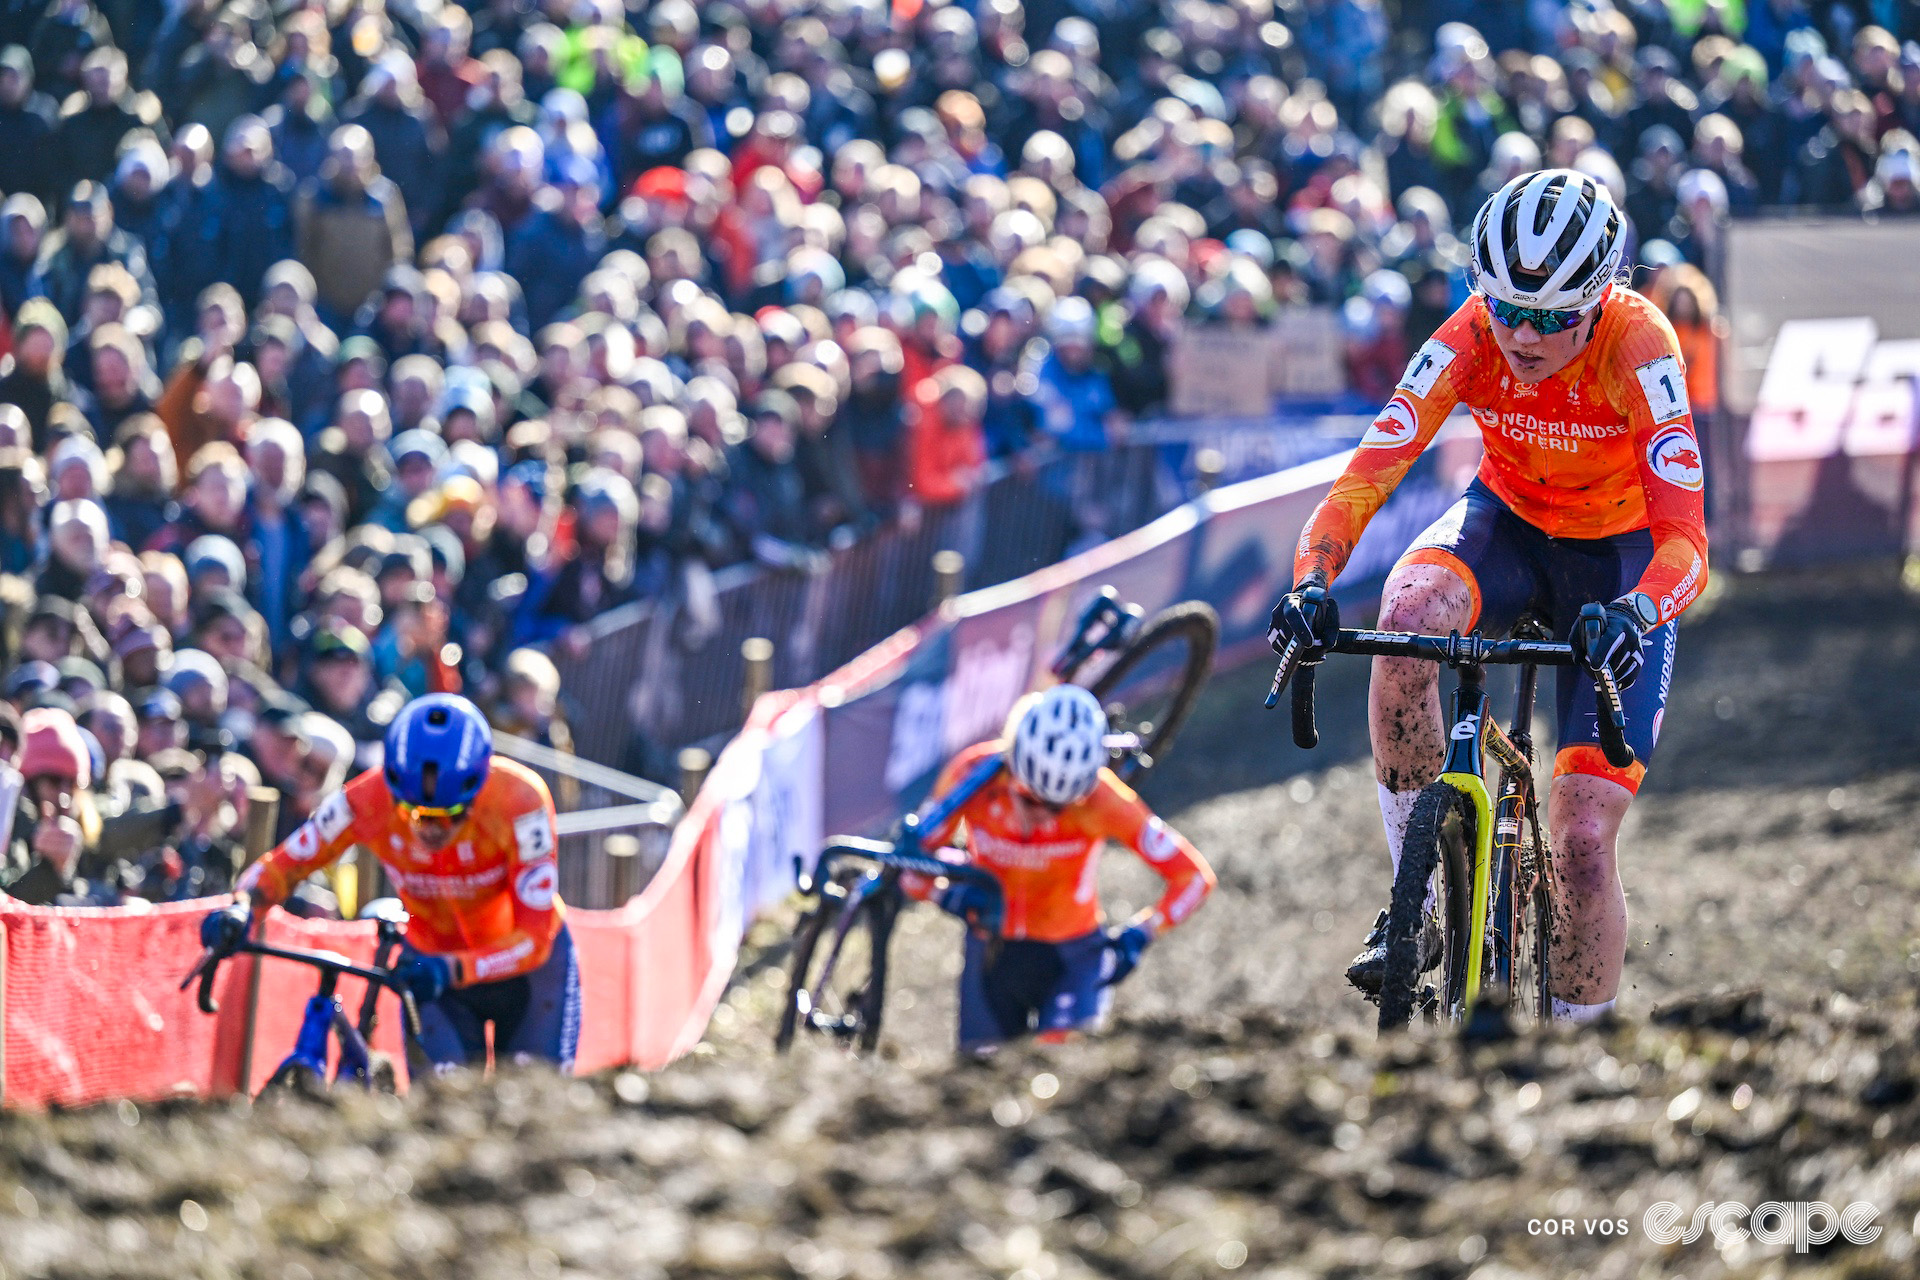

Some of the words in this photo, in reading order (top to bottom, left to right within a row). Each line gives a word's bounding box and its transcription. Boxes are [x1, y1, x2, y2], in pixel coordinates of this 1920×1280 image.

[1582, 249, 1619, 299] GIRO
[1512, 293, 1538, 303] GIRO
[1411, 354, 1432, 377] 1
[1659, 374, 1677, 404] 1
[1501, 424, 1578, 453] LOTERIJ
[1502, 412, 1628, 439] NEDERLANDSE
[1671, 549, 1703, 601] NEDERLANDSE
[1270, 639, 1298, 696] SRAM
[1601, 663, 1623, 712] RAM
